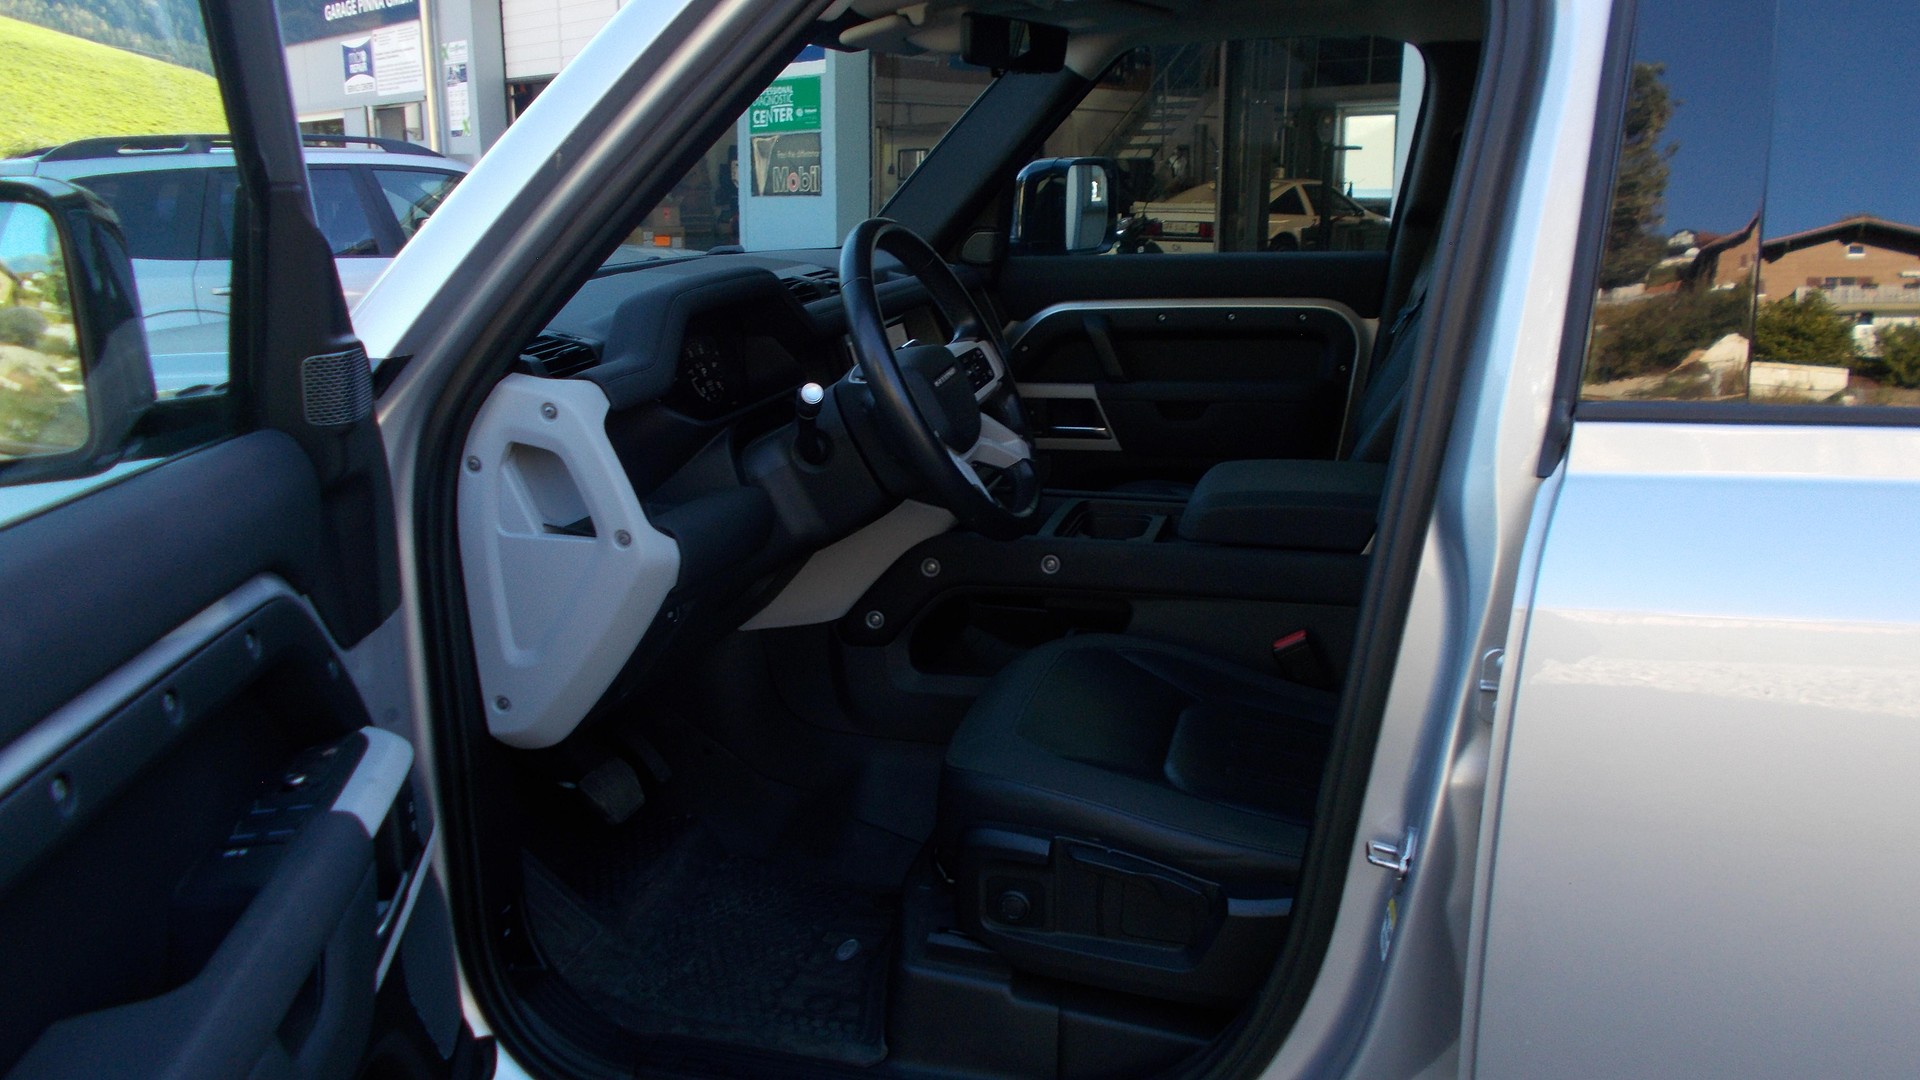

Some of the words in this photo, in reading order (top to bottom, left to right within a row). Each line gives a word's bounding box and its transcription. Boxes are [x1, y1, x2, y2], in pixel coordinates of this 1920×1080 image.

[324, 0, 358, 21] GARAGE
[753, 107, 794, 124] CENTER
[772, 165, 821, 193] Mobil
